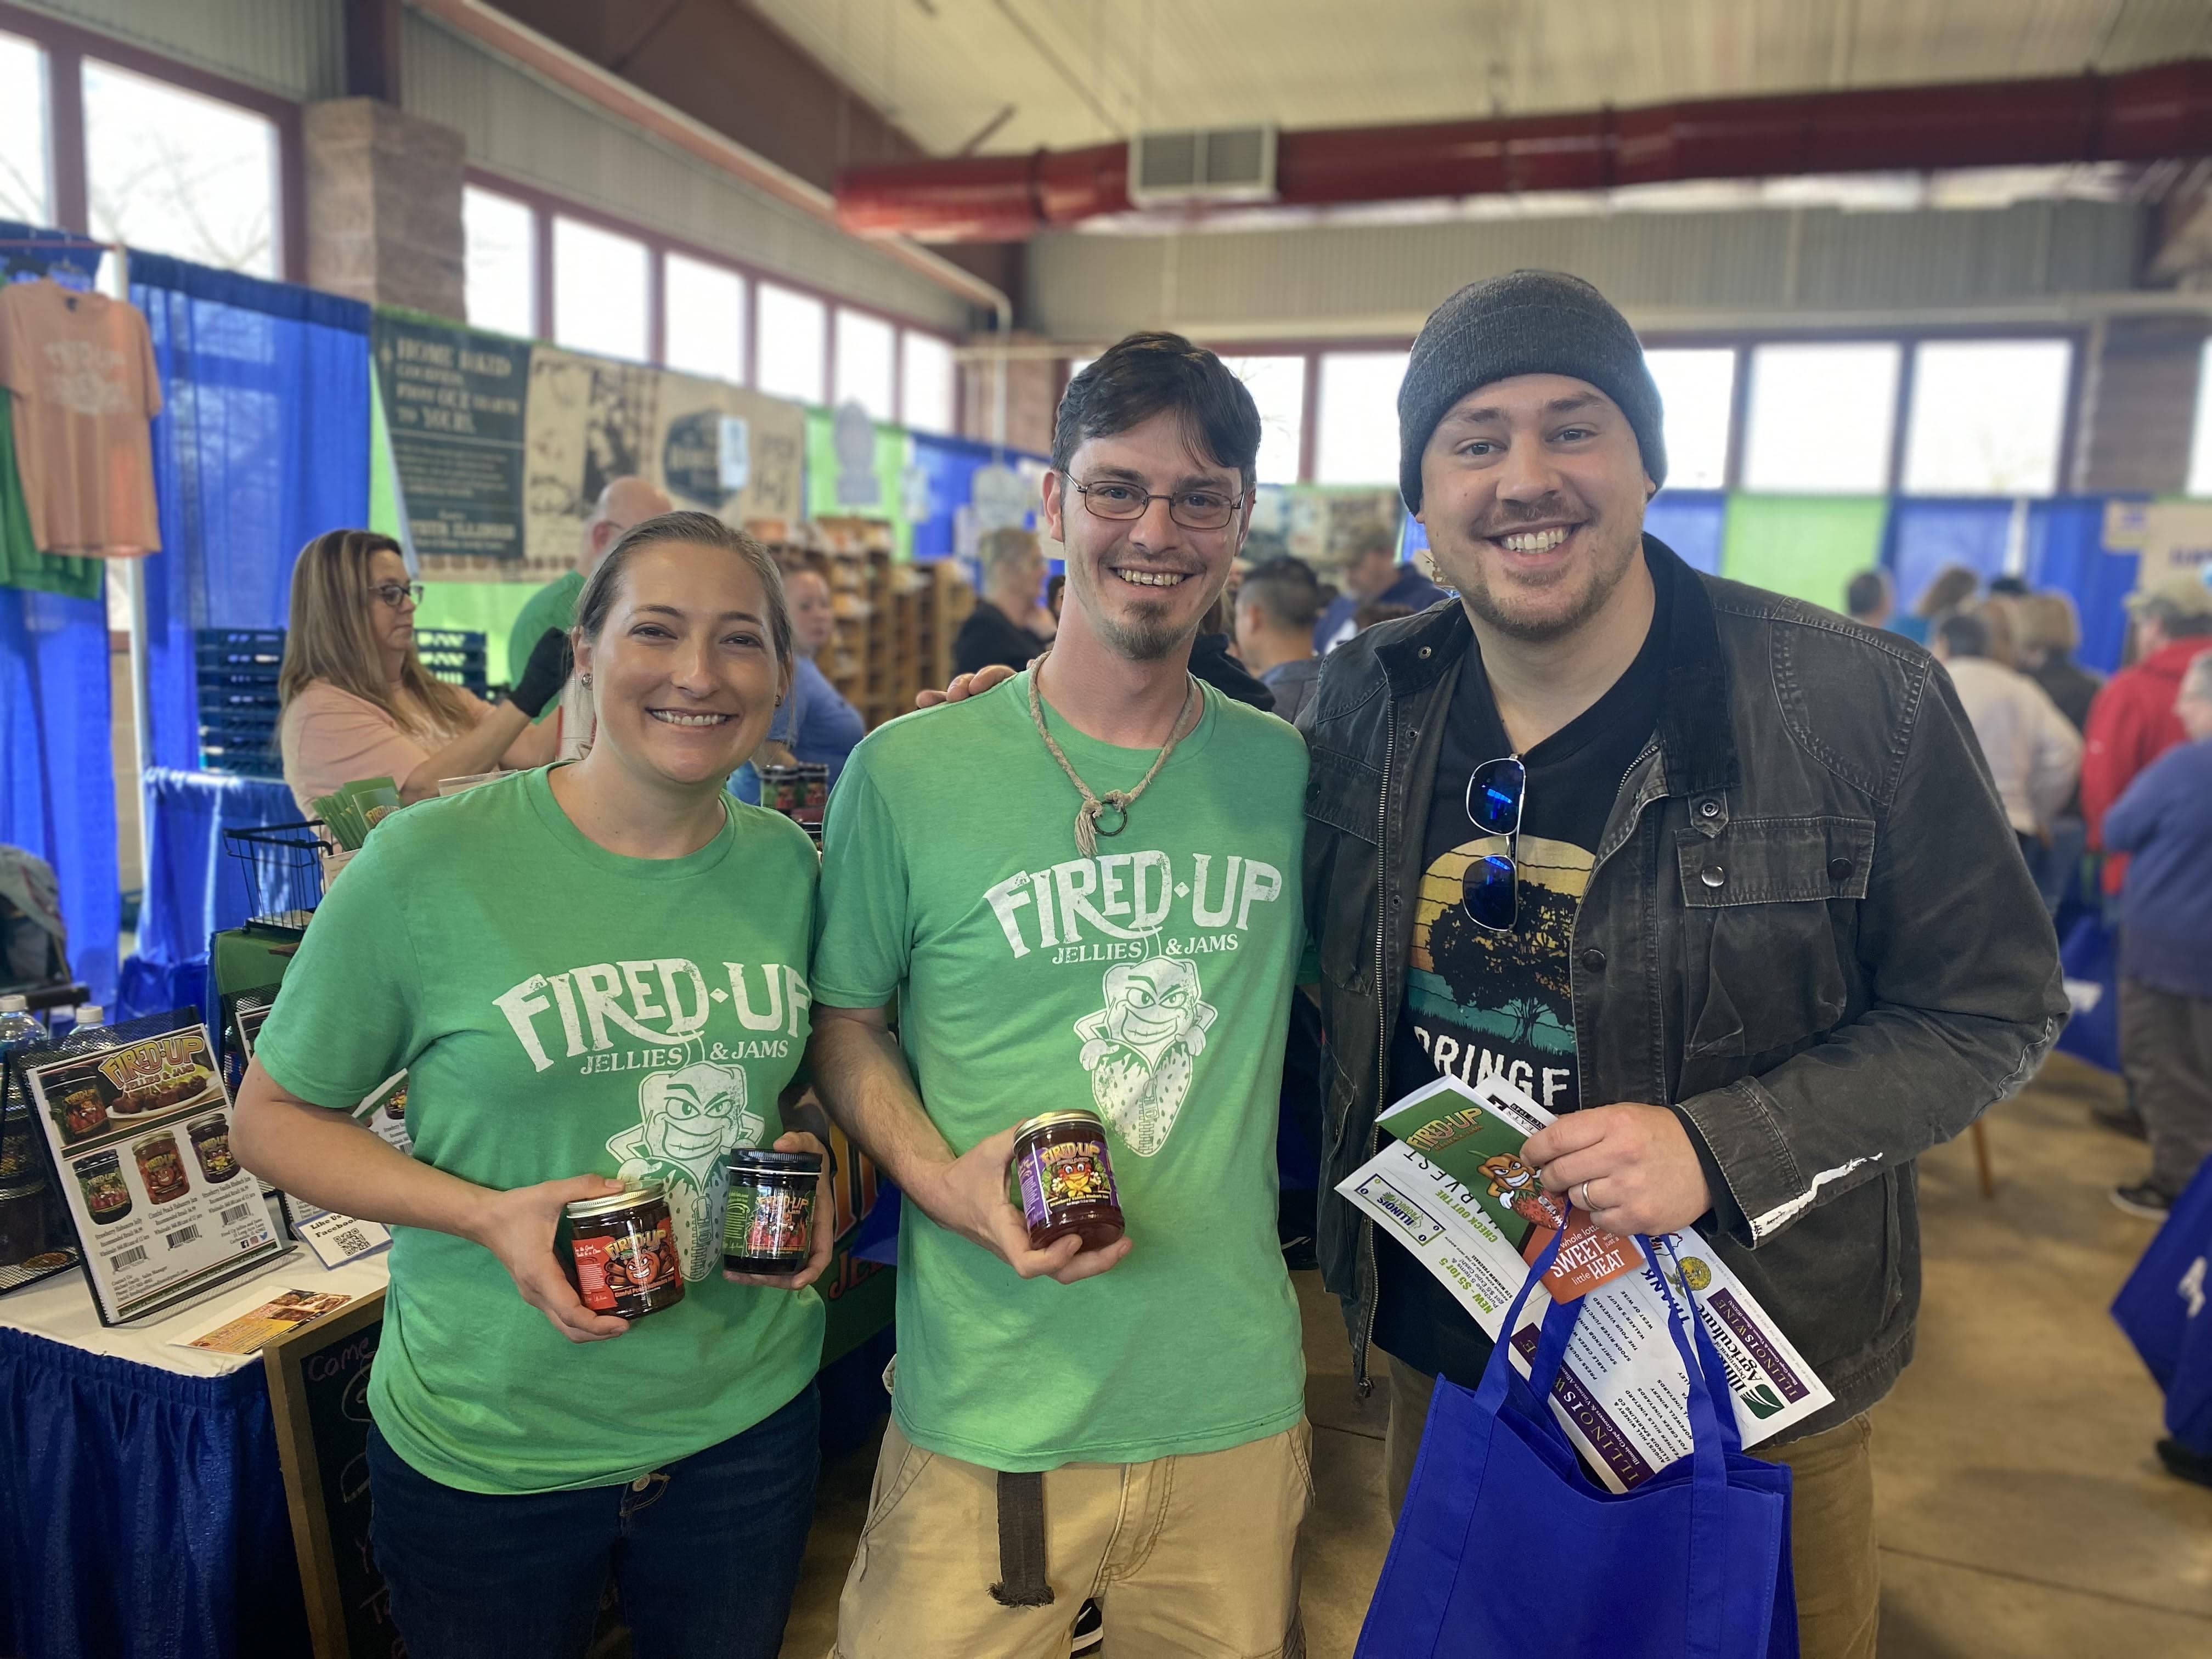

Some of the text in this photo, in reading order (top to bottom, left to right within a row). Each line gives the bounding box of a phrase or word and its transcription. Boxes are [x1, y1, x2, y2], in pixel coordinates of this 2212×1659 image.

[1052, 934, 1238, 964] JELLIES & JAMS
[580, 1040, 789, 1075] JELLIES & JAMS
[1505, 1110, 1534, 1131] EATS
[1375, 1196, 1415, 1226] ILLINOIS
[1434, 1188, 1499, 1243] CHECK OUT THE
[310, 1219, 330, 1229] Like
[315, 1217, 357, 1238] Faceboo
[1559, 1231, 1582, 1249] whole
[1604, 1238, 1616, 1249] just
[1438, 1256, 1449, 1266] 5
[1550, 1234, 1605, 1278] SWEET
[1571, 1249, 1625, 1286] little HEAT
[1444, 1263, 1461, 1278] for
[1457, 1275, 1472, 1290] $5
[1473, 1272, 1488, 1287] Expo
[1472, 1291, 1494, 1314] NEW
[1474, 1282, 1499, 1309] Purchase
[1485, 1285, 1496, 1296] $5
[1606, 1293, 1623, 1312] BLUFF
[1620, 1290, 1654, 1330] WEST OF WISE
[1581, 1302, 1631, 1362] SPOON RIVER JUNCTIO
[1592, 1296, 1638, 1351] THE POUR VINEYARD
[1576, 1316, 1617, 1365] SPIRIT KNOB WINE
[1690, 1300, 1767, 1387] Agriculture
[1576, 1336, 1608, 1374] SABLE CREEK
[1713, 1340, 1747, 1380] Department of
[1556, 1363, 1575, 1385] Allianc
[1581, 1362, 1598, 1380] PRESS
[1637, 1387, 1663, 1419] VINEYARDS
[1650, 1387, 1669, 1409] WINERY
[1656, 1379, 1684, 1410] VINEYARDS
[1617, 1406, 1637, 1429] WINERY
[1617, 1397, 1671, 1462] ILLINOIS SPARKLING CO
[1624, 1389, 1681, 1459] FEATHER HILLS VINEYARD
[1635, 1428, 1647, 1442] HILL
[1676, 1438, 1688, 1451] FOX
[1645, 1440, 1666, 1464] AUGUST
